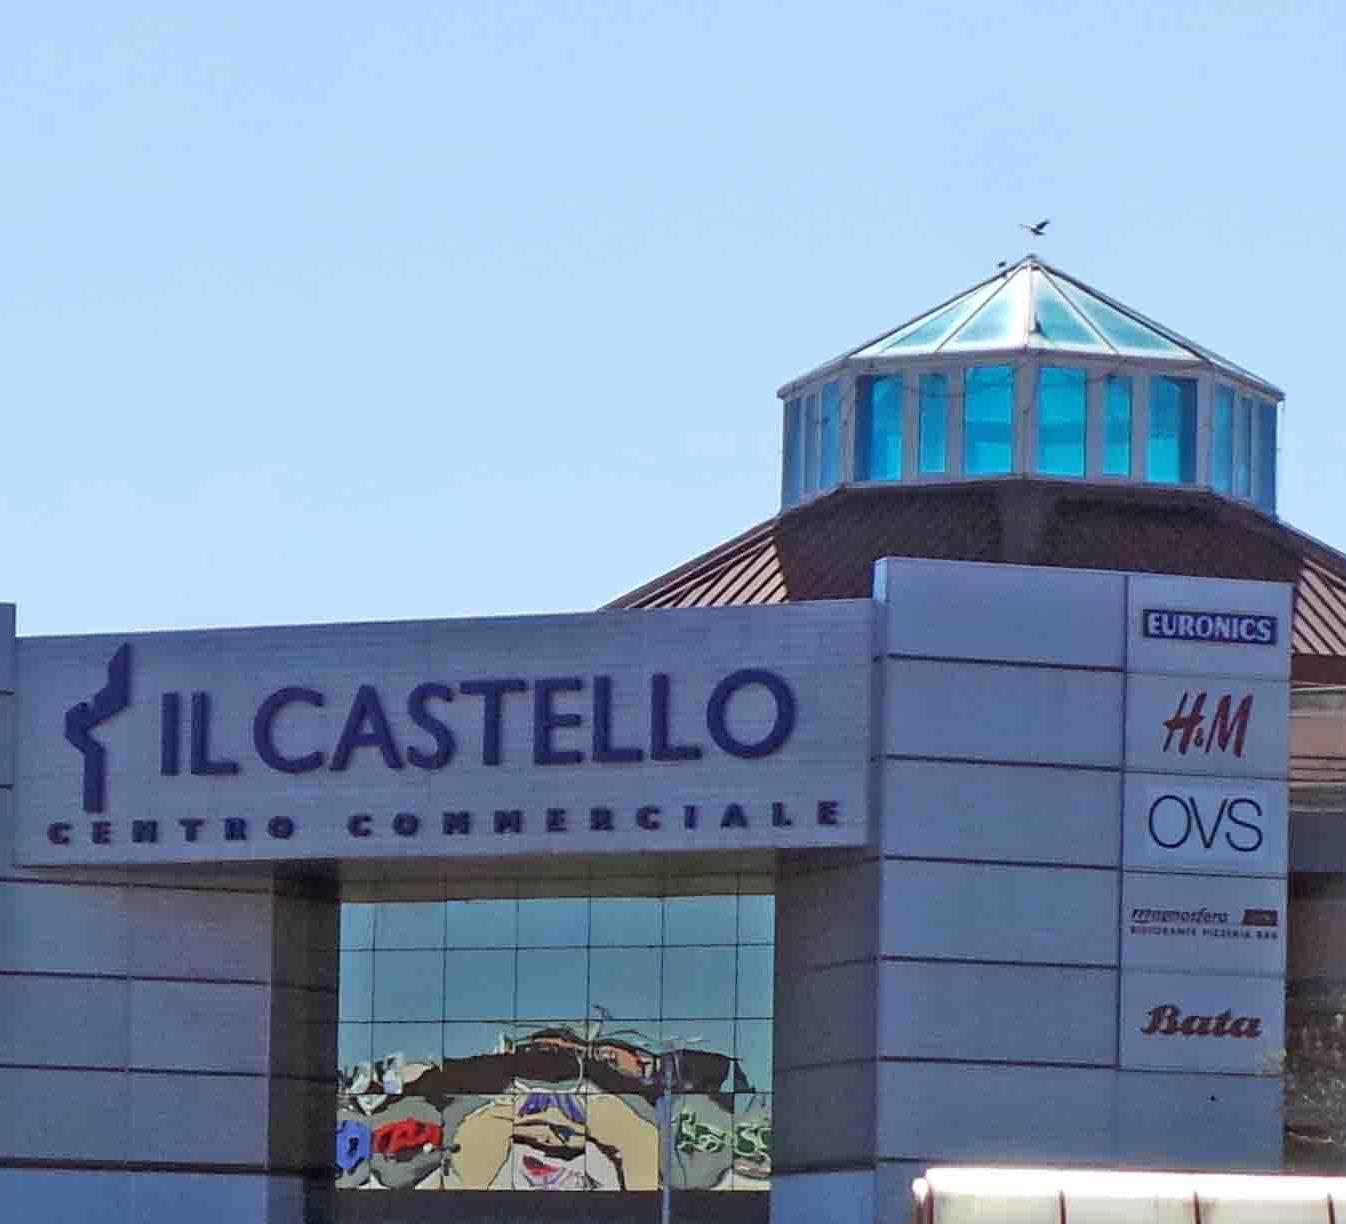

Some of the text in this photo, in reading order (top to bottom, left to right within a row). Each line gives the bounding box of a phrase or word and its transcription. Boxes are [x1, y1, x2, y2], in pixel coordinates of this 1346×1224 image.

[1146, 614, 1274, 643] EURONICS
[1162, 690, 1254, 759] H&M
[46, 799, 844, 847] CENTRO COMMERCIALE
[1147, 793, 1264, 854] OVS
[1140, 1003, 1263, 1040] Bata
